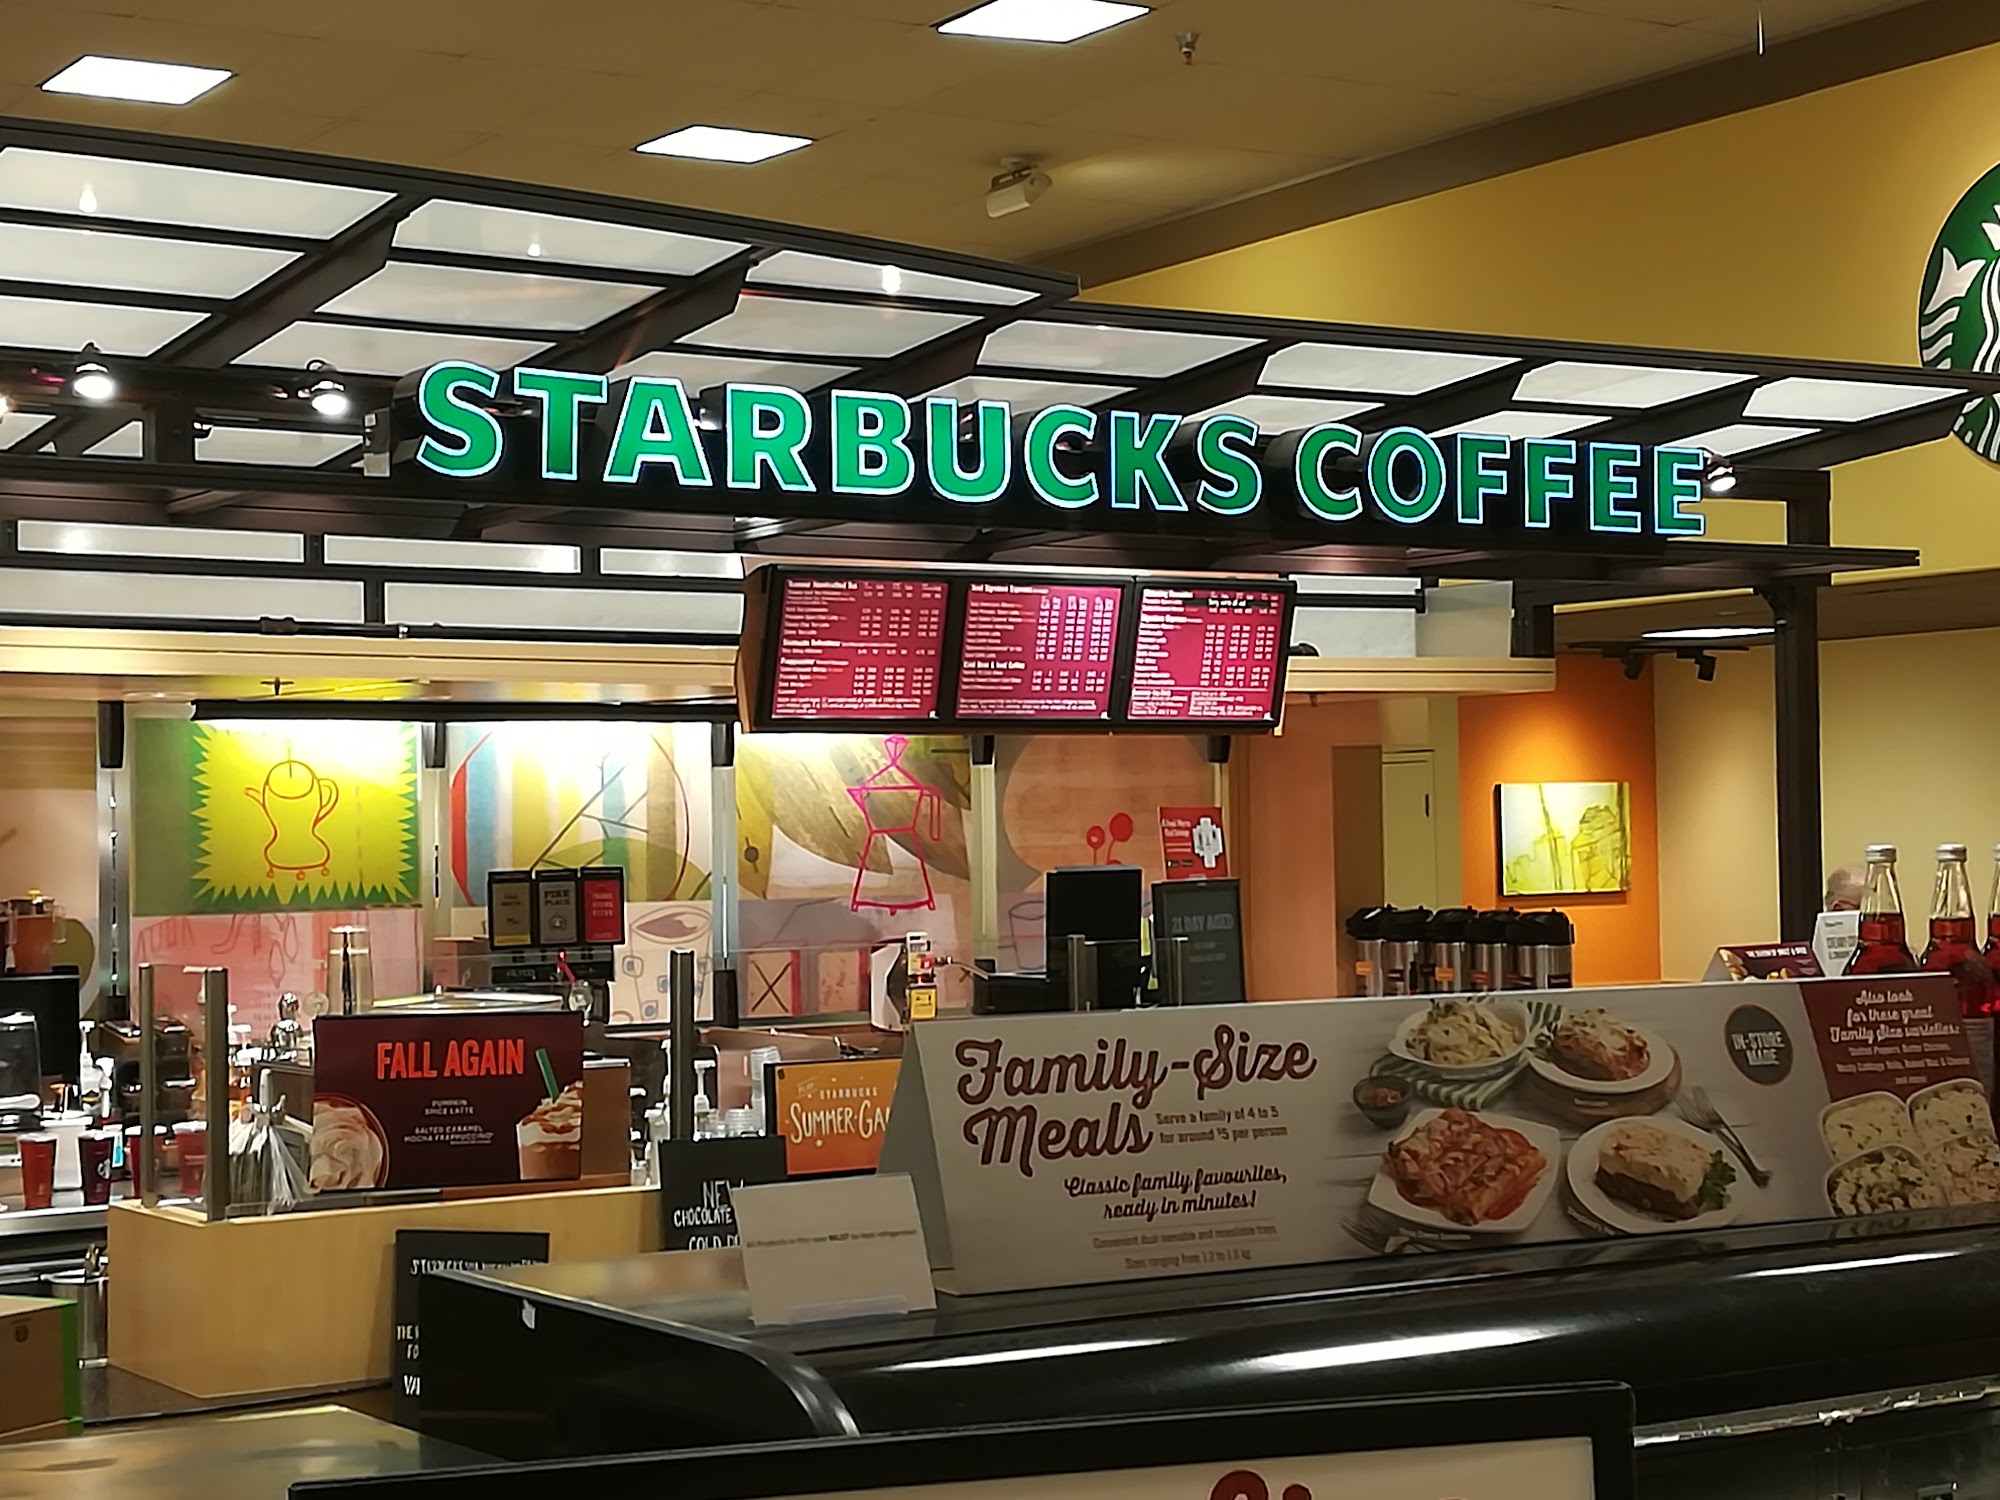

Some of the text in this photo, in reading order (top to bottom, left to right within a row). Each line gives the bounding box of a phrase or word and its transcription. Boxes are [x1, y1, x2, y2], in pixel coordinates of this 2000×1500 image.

[416, 360, 1704, 536] STARBUCKS COFFEE
[1855, 988, 1914, 1006] Also look
[1846, 1004, 1934, 1027] for these great
[1732, 1030, 1786, 1052] IN-STORE
[376, 1038, 525, 1081] FALL AGAIN
[1747, 1048, 1781, 1067] MADE
[819, 1086, 878, 1101] STARBUCKS
[449, 1105, 475, 1115] LATTE
[1154, 1112, 1187, 1125] Serve
[1199, 1109, 1232, 1124] family
[1234, 1107, 1245, 1120] of
[1247, 1107, 1256, 1119] 4
[1257, 1107, 1269, 1119] to
[1270, 1105, 1280, 1118] 5
[414, 1124, 483, 1135] SALTED CARAMEL
[789, 1101, 856, 1144] SUMMER
[403, 1134, 433, 1143] MOCHA
[963, 1102, 1154, 1178] Meals
[1063, 1164, 1289, 1199] Classic family favourites,
[673, 1205, 733, 1228] CHOCOLATE
[1103, 1190, 1257, 1223] ready in minutes!
